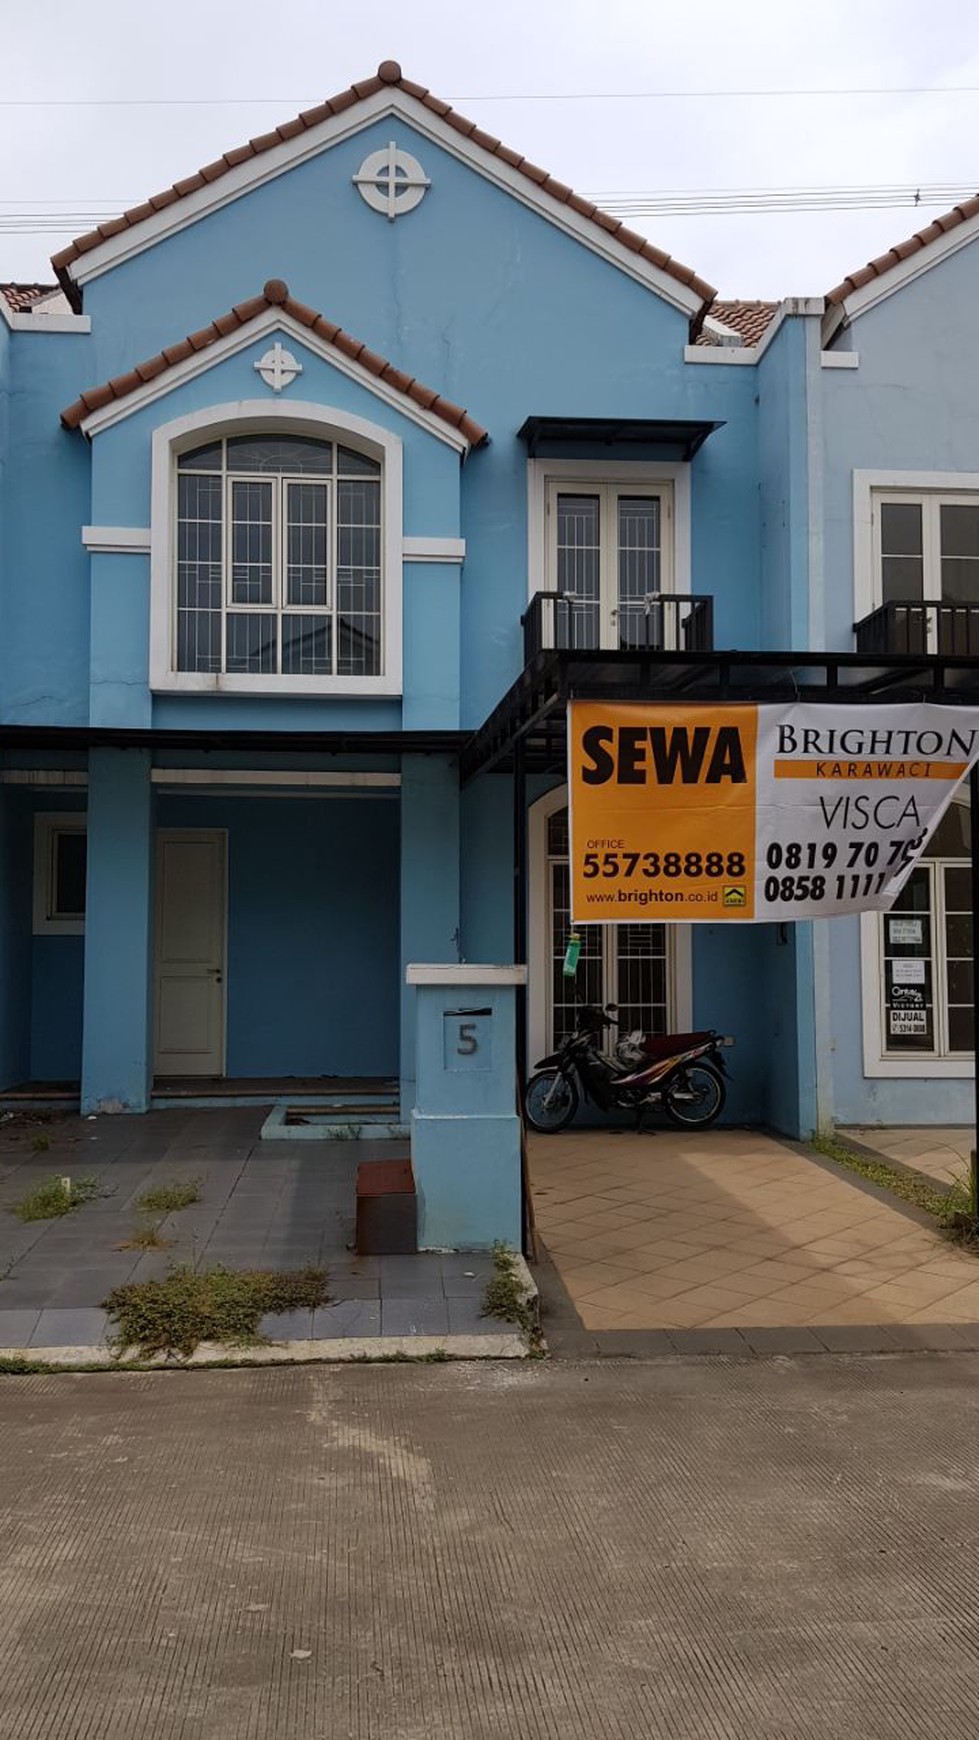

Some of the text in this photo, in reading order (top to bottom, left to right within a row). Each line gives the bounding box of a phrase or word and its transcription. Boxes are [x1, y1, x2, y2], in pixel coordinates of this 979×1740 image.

[776, 724, 978, 757] BRIGHTON
[582, 725, 747, 785] SEWA
[816, 762, 931, 777] KARAWACI
[819, 795, 920, 830] VISCA
[587, 839, 625, 849] OFFICE
[767, 842, 837, 870] 0819
[846, 842, 879, 868] 70
[583, 852, 746, 879] 55738888
[586, 889, 718, 905] www.brighton.co.id
[764, 872, 886, 902] 0858 1111
[892, 1012, 924, 1022] DIJUAL
[457, 1023, 479, 1056] 5
